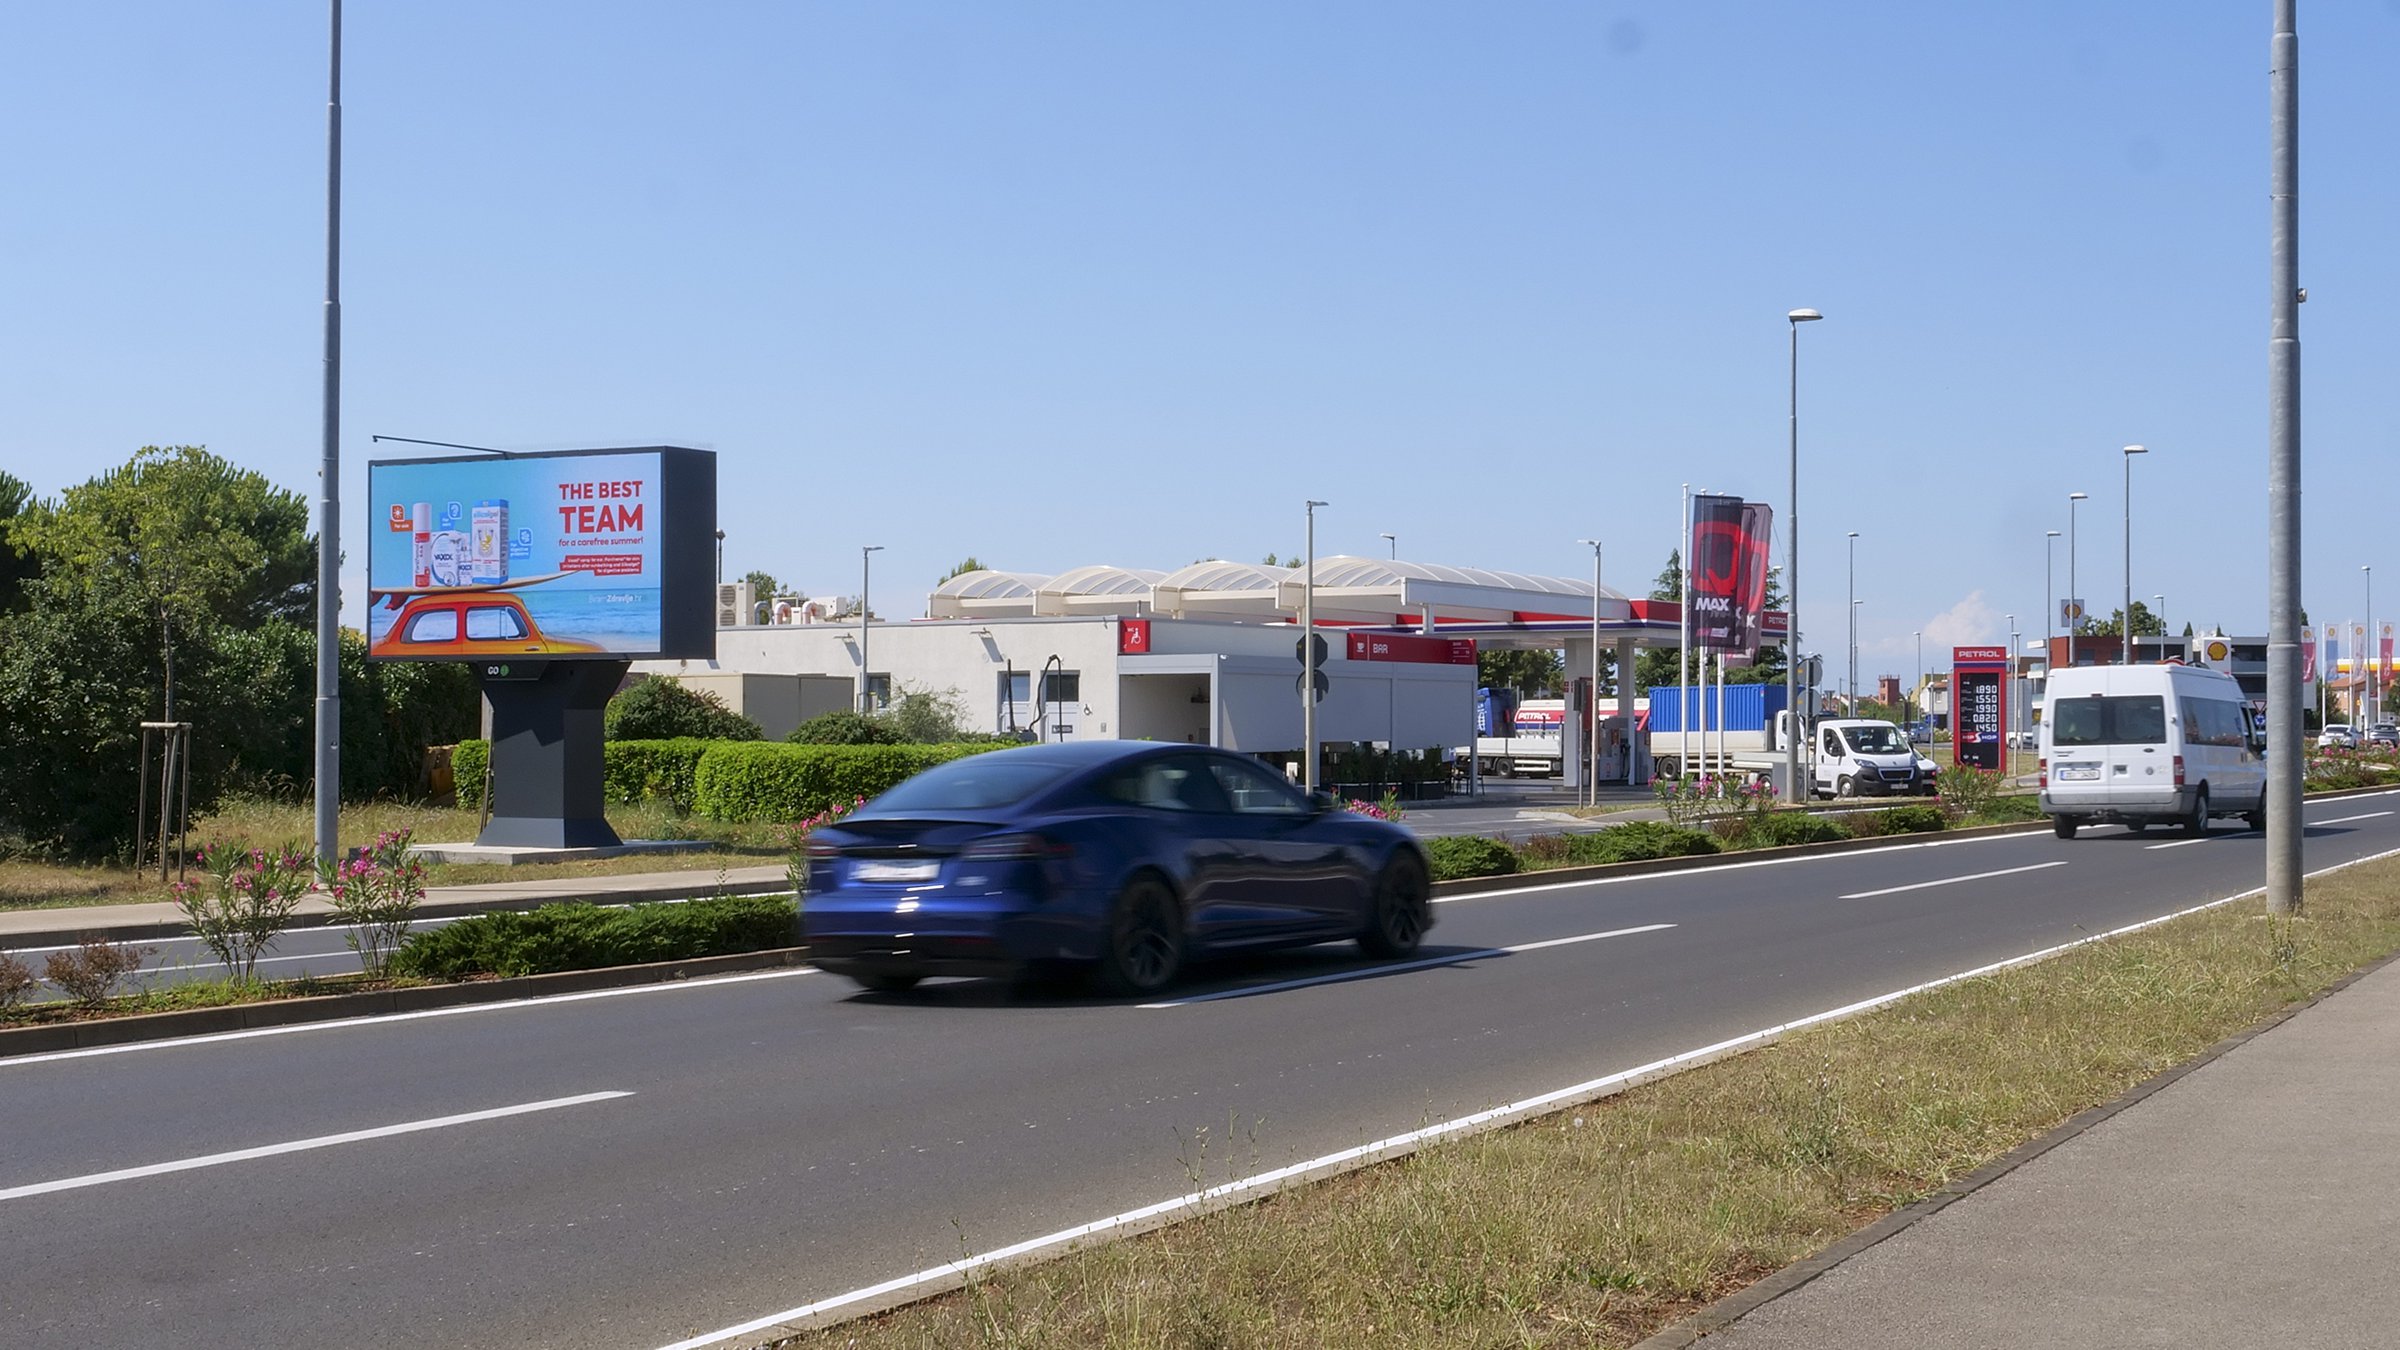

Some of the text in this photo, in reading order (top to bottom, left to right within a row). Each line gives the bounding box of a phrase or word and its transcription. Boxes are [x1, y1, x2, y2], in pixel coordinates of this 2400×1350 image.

[559, 480, 642, 500] THE BEST
[559, 504, 643, 533] TEAM
[559, 538, 569, 546] for
[577, 538, 609, 546] carefree
[611, 536, 643, 545] summer!
[1695, 597, 1729, 611] MAX
[1768, 616, 1787, 625] PETRO
[1373, 643, 1388, 654] BAR
[1959, 650, 2000, 658] PETROL
[1518, 711, 1551, 721] PETROL
